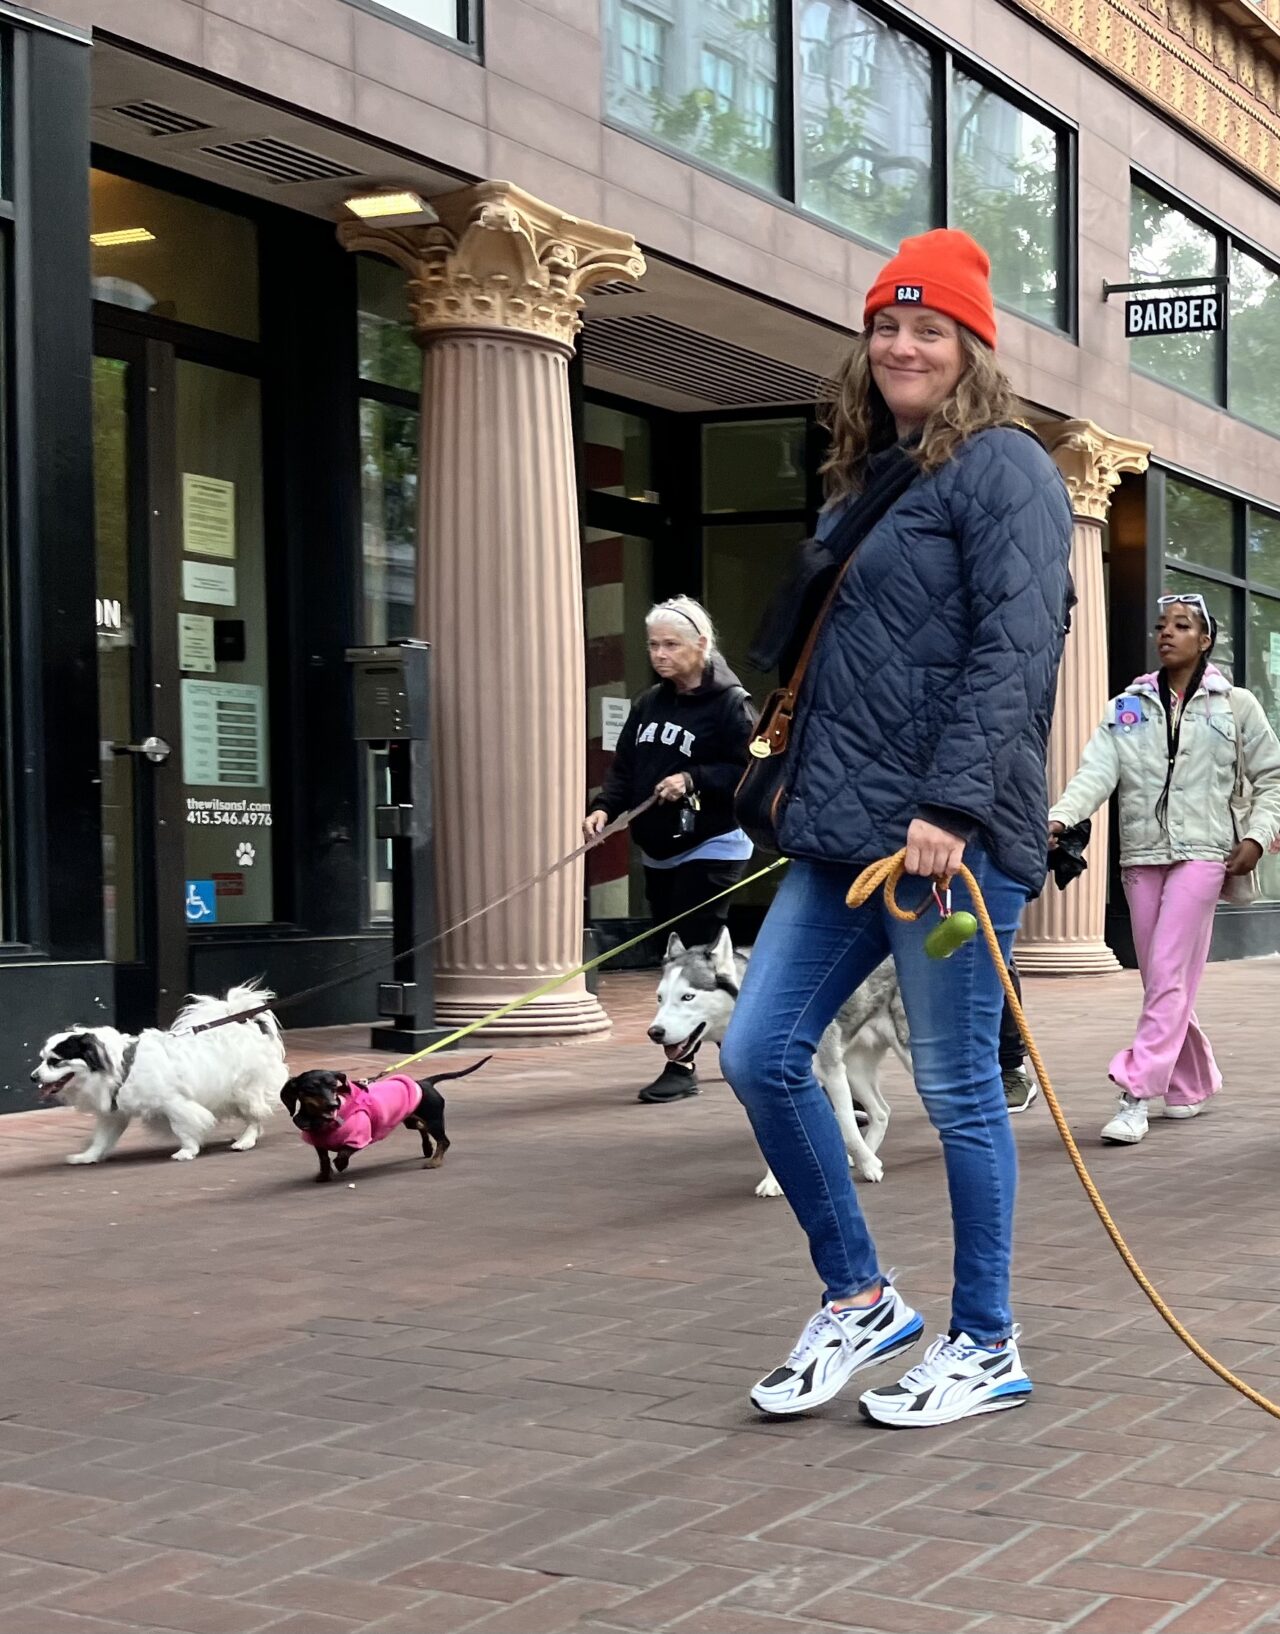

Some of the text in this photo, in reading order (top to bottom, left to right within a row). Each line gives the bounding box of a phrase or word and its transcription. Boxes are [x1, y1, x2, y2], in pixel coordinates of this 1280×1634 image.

[897, 287, 920, 301] GAP
[1129, 298, 1217, 332] BARBER
[635, 721, 696, 757] AUI
[186, 798, 271, 811] thewilsonsf.com
[186, 811, 272, 826] 415.546.4976
